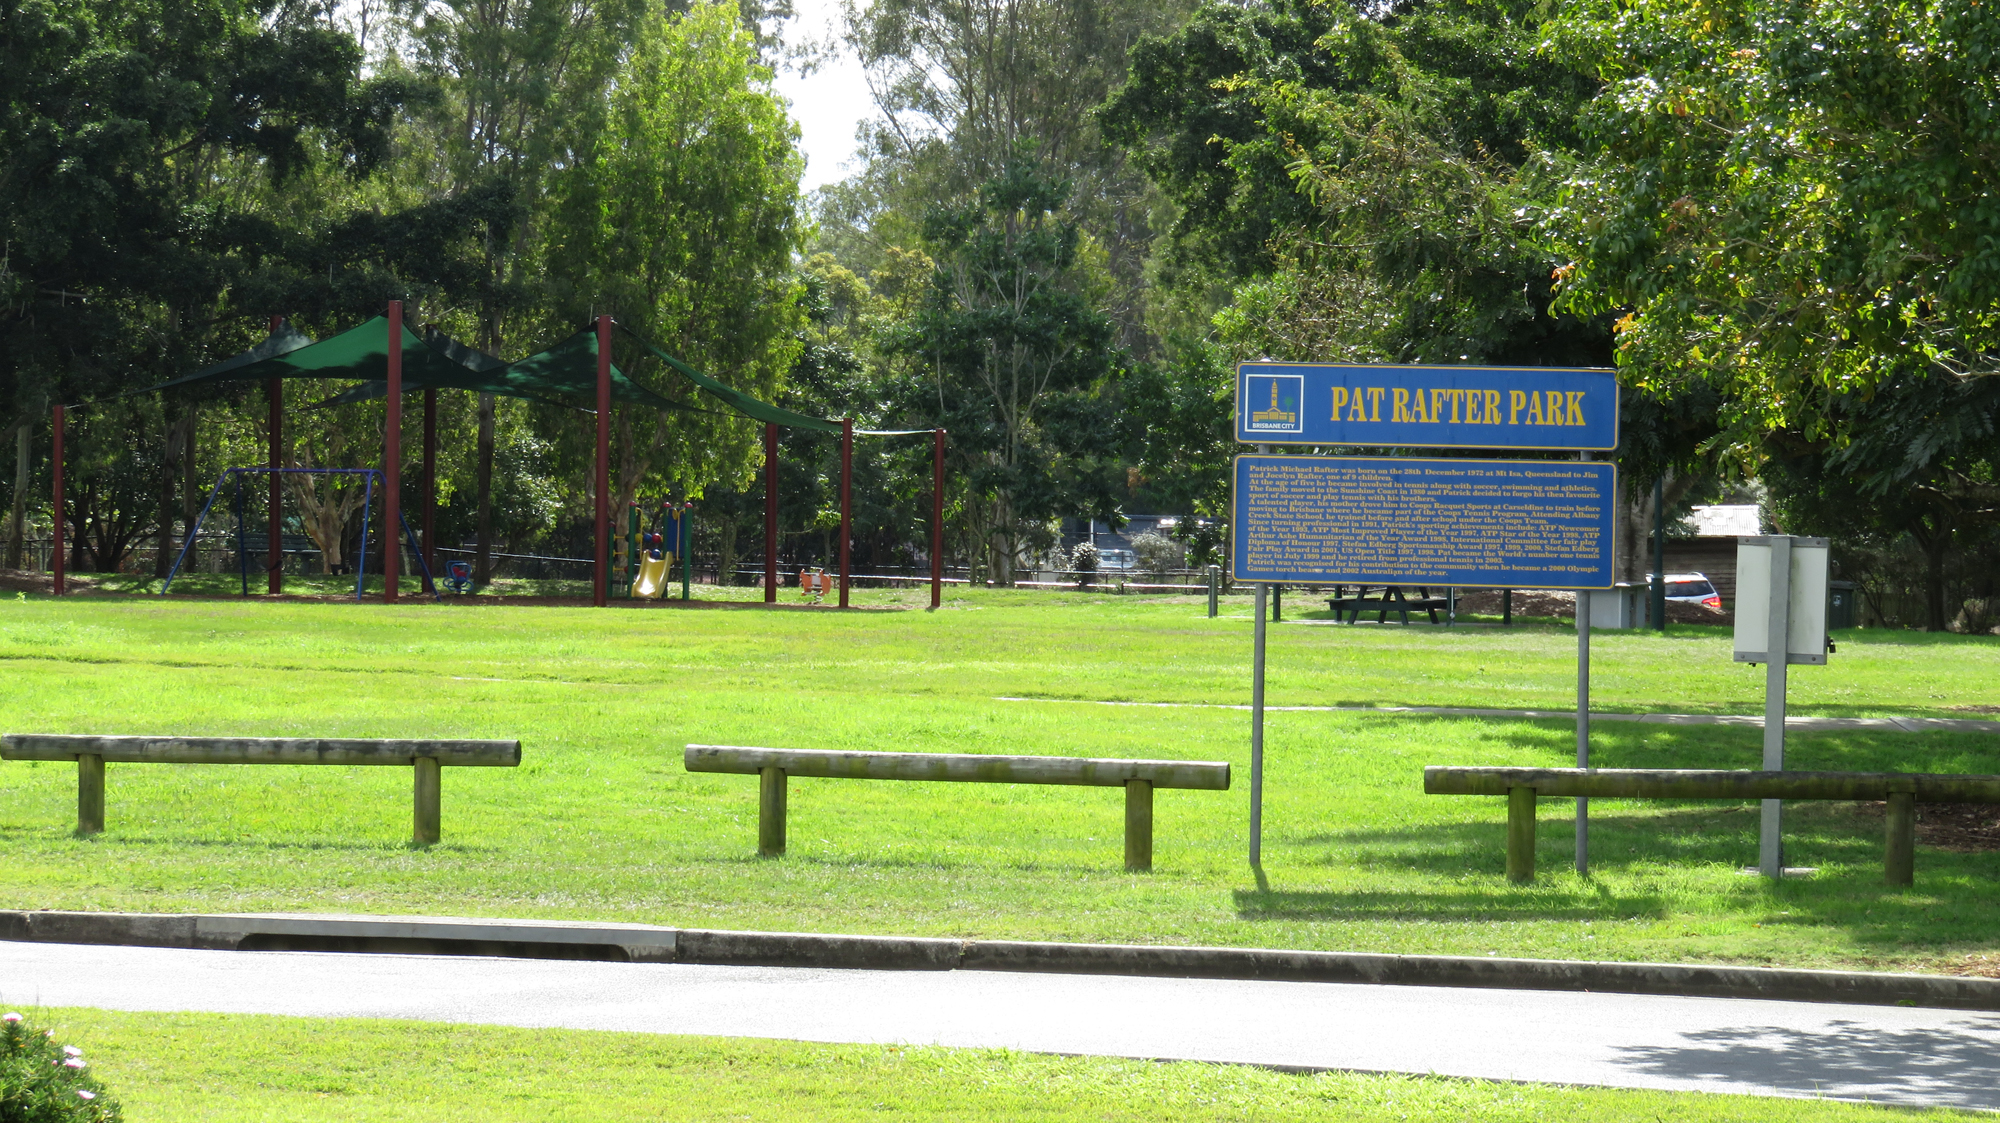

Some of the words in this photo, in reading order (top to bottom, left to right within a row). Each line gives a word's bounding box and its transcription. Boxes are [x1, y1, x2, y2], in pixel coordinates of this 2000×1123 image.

[1331, 386, 1385, 422] PAT
[1391, 388, 1502, 425] RAFTER
[1508, 390, 1587, 426] PARK
[1265, 472, 1296, 480] Jocelyn
[1524, 471, 1572, 479] Queensland
[1502, 484, 1543, 492] swimming
[1248, 492, 1269, 500] sport
[1265, 486, 1289, 494] family
[1512, 491, 1533, 499] forgo
[1409, 502, 1432, 510] Coops
[1433, 503, 1466, 511] Racquet
[1466, 503, 1492, 511] Sports
[1248, 505, 1278, 513] moving
[1437, 509, 1462, 517] Coops
[1531, 511, 1571, 519] Attending
[1572, 512, 1600, 520] Albany
[1271, 519, 1301, 527] turning
[1302, 520, 1350, 528] professional
[1417, 522, 1450, 530] sporting
[1498, 517, 1523, 525] Coops
[1580, 539, 1597, 547] play
[1293, 560, 1335, 568] recognised
[1434, 563, 1477, 571] community
[1566, 566, 1599, 574] Olympic
